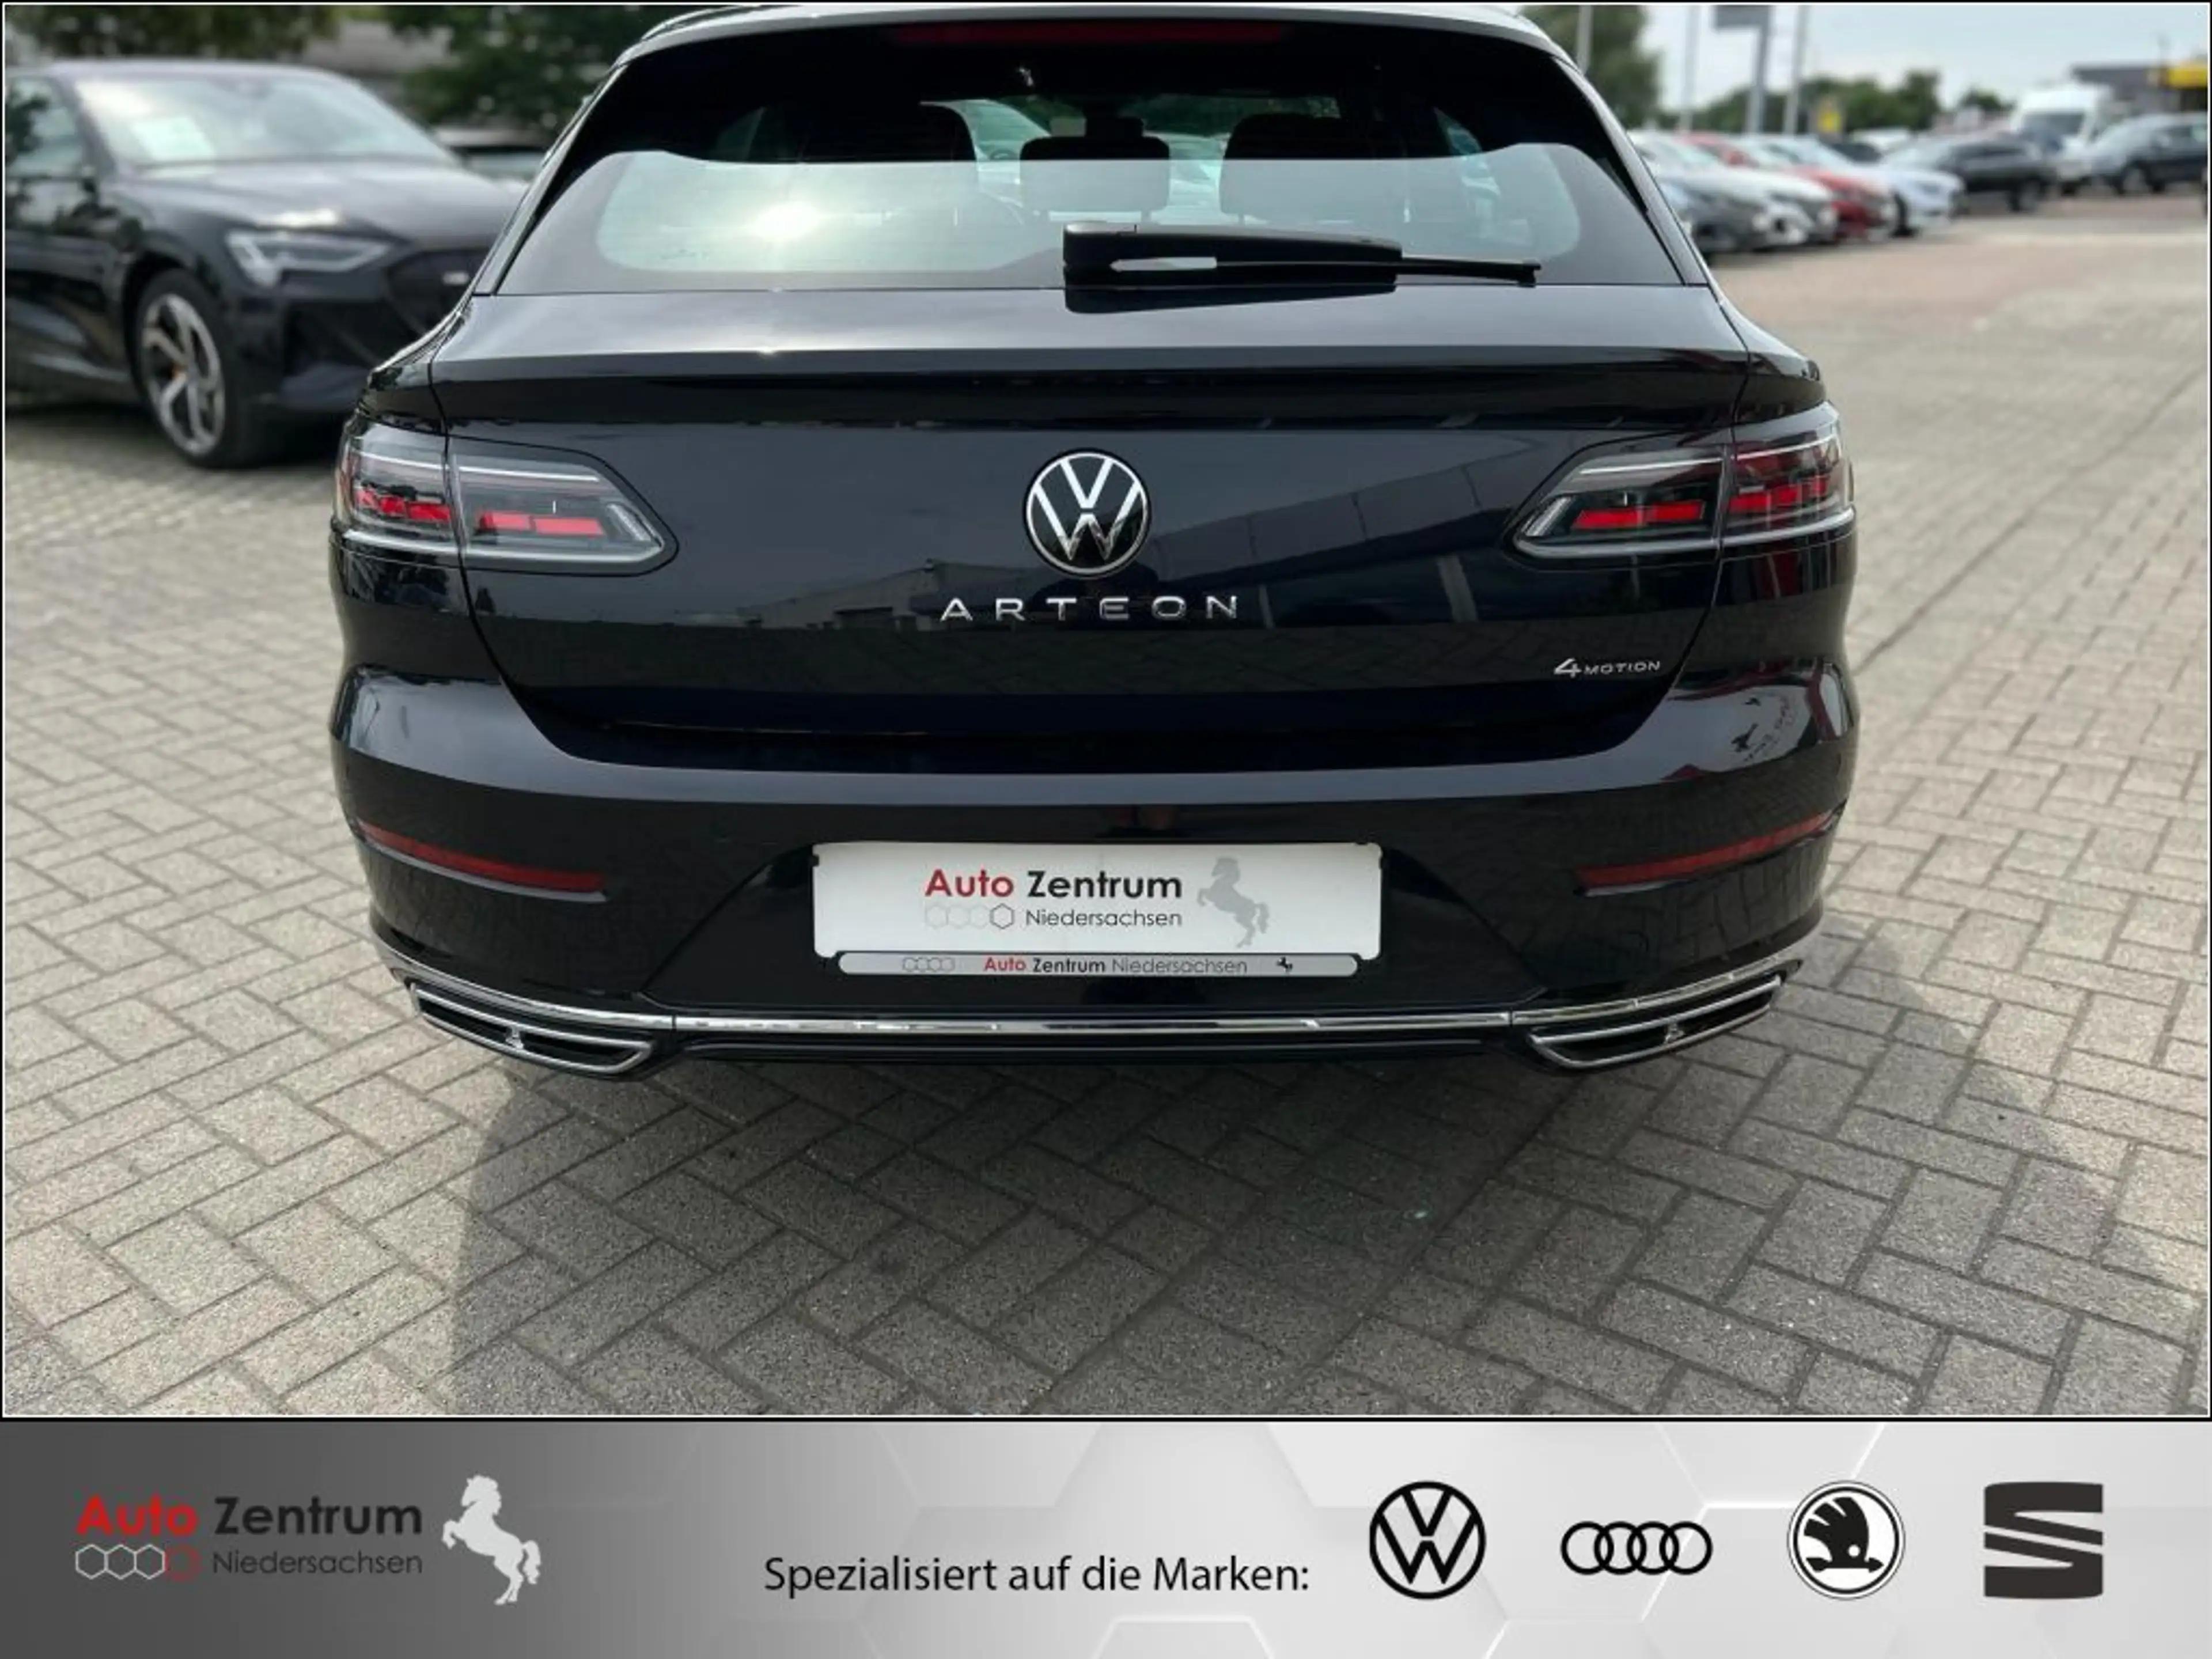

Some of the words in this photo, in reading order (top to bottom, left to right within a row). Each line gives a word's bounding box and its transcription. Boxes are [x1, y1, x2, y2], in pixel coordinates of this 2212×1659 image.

[940, 596, 1237, 622] ARTEON
[925, 869, 1014, 899] Auto
[1027, 870, 1183, 899] Zentrum
[1025, 909, 1183, 928] Niedersachsen
[984, 956, 1027, 973] Auto
[1032, 957, 1107, 974] Zentrum
[1112, 957, 1248, 974] Niedersachsen
